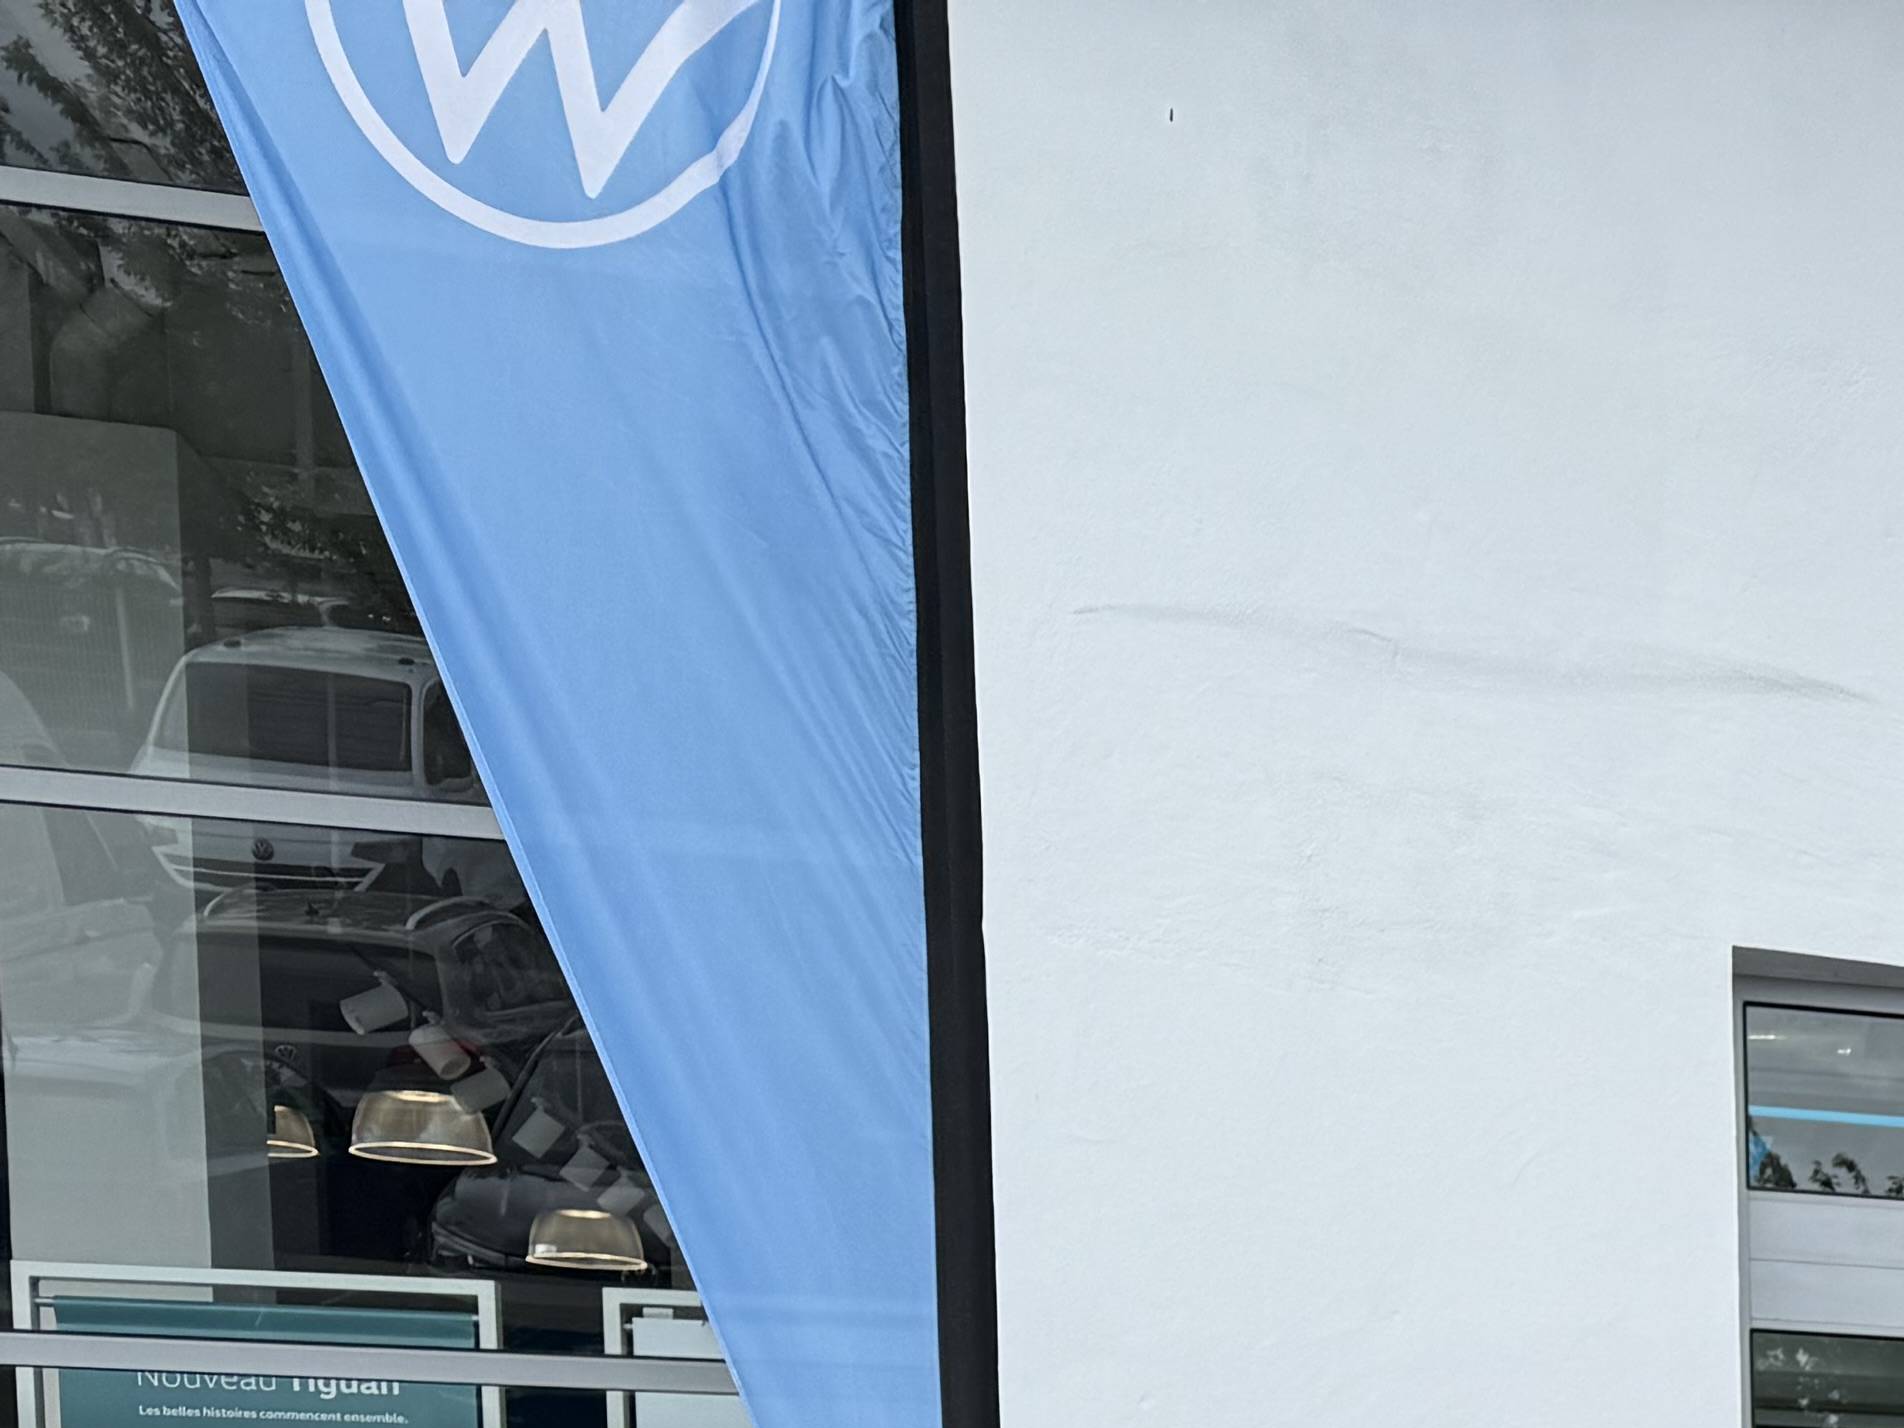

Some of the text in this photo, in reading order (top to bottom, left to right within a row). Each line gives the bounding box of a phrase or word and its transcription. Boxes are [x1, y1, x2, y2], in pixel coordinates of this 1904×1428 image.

[138, 1404, 409, 1424] Les belles histoires commencent ensemble.
